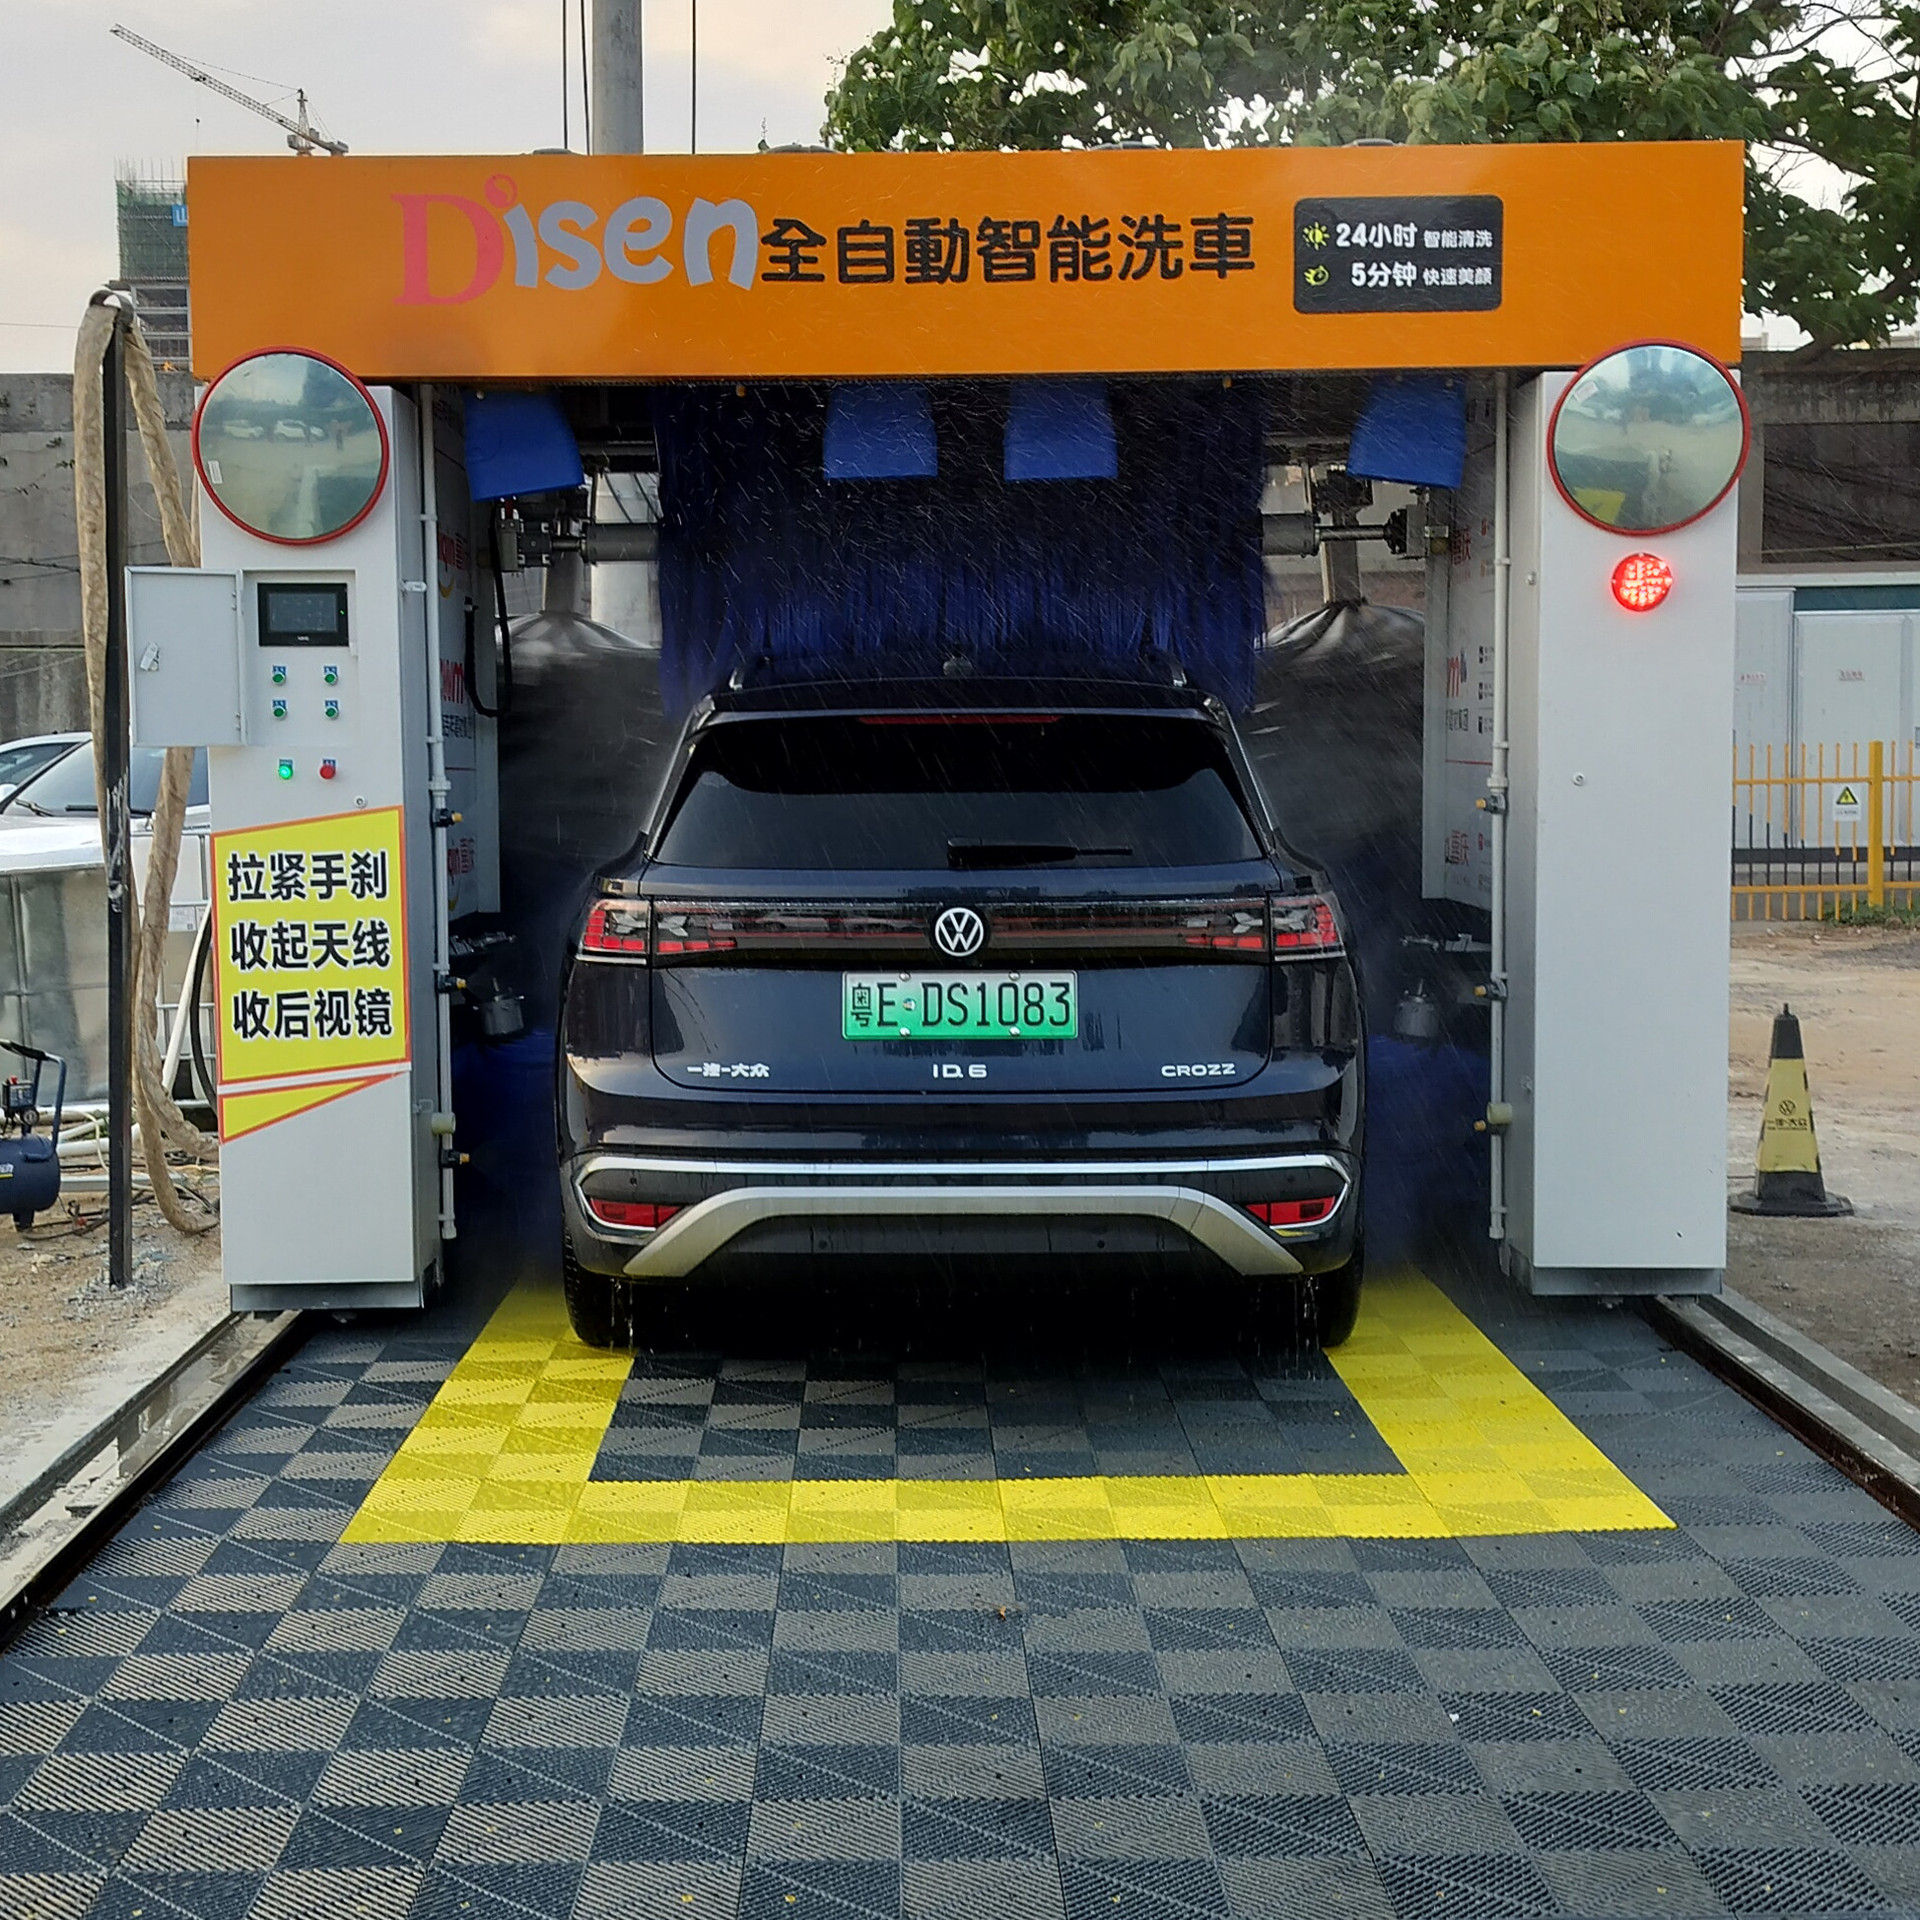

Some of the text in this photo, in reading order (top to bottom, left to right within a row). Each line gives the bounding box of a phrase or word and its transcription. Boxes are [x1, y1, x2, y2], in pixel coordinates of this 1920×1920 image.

[390, 174, 758, 305] Disen
[760, 213, 1255, 284] 全自動智能洗車
[1335, 222, 1494, 249] 24小时 智能清洗
[1351, 261, 1418, 288] 5分钟
[228, 851, 388, 901] 拉紧手刹
[230, 920, 391, 970] 收起天线
[232, 988, 392, 1039] 收后视镜
[1161, 1062, 1236, 1077] CROZZ
